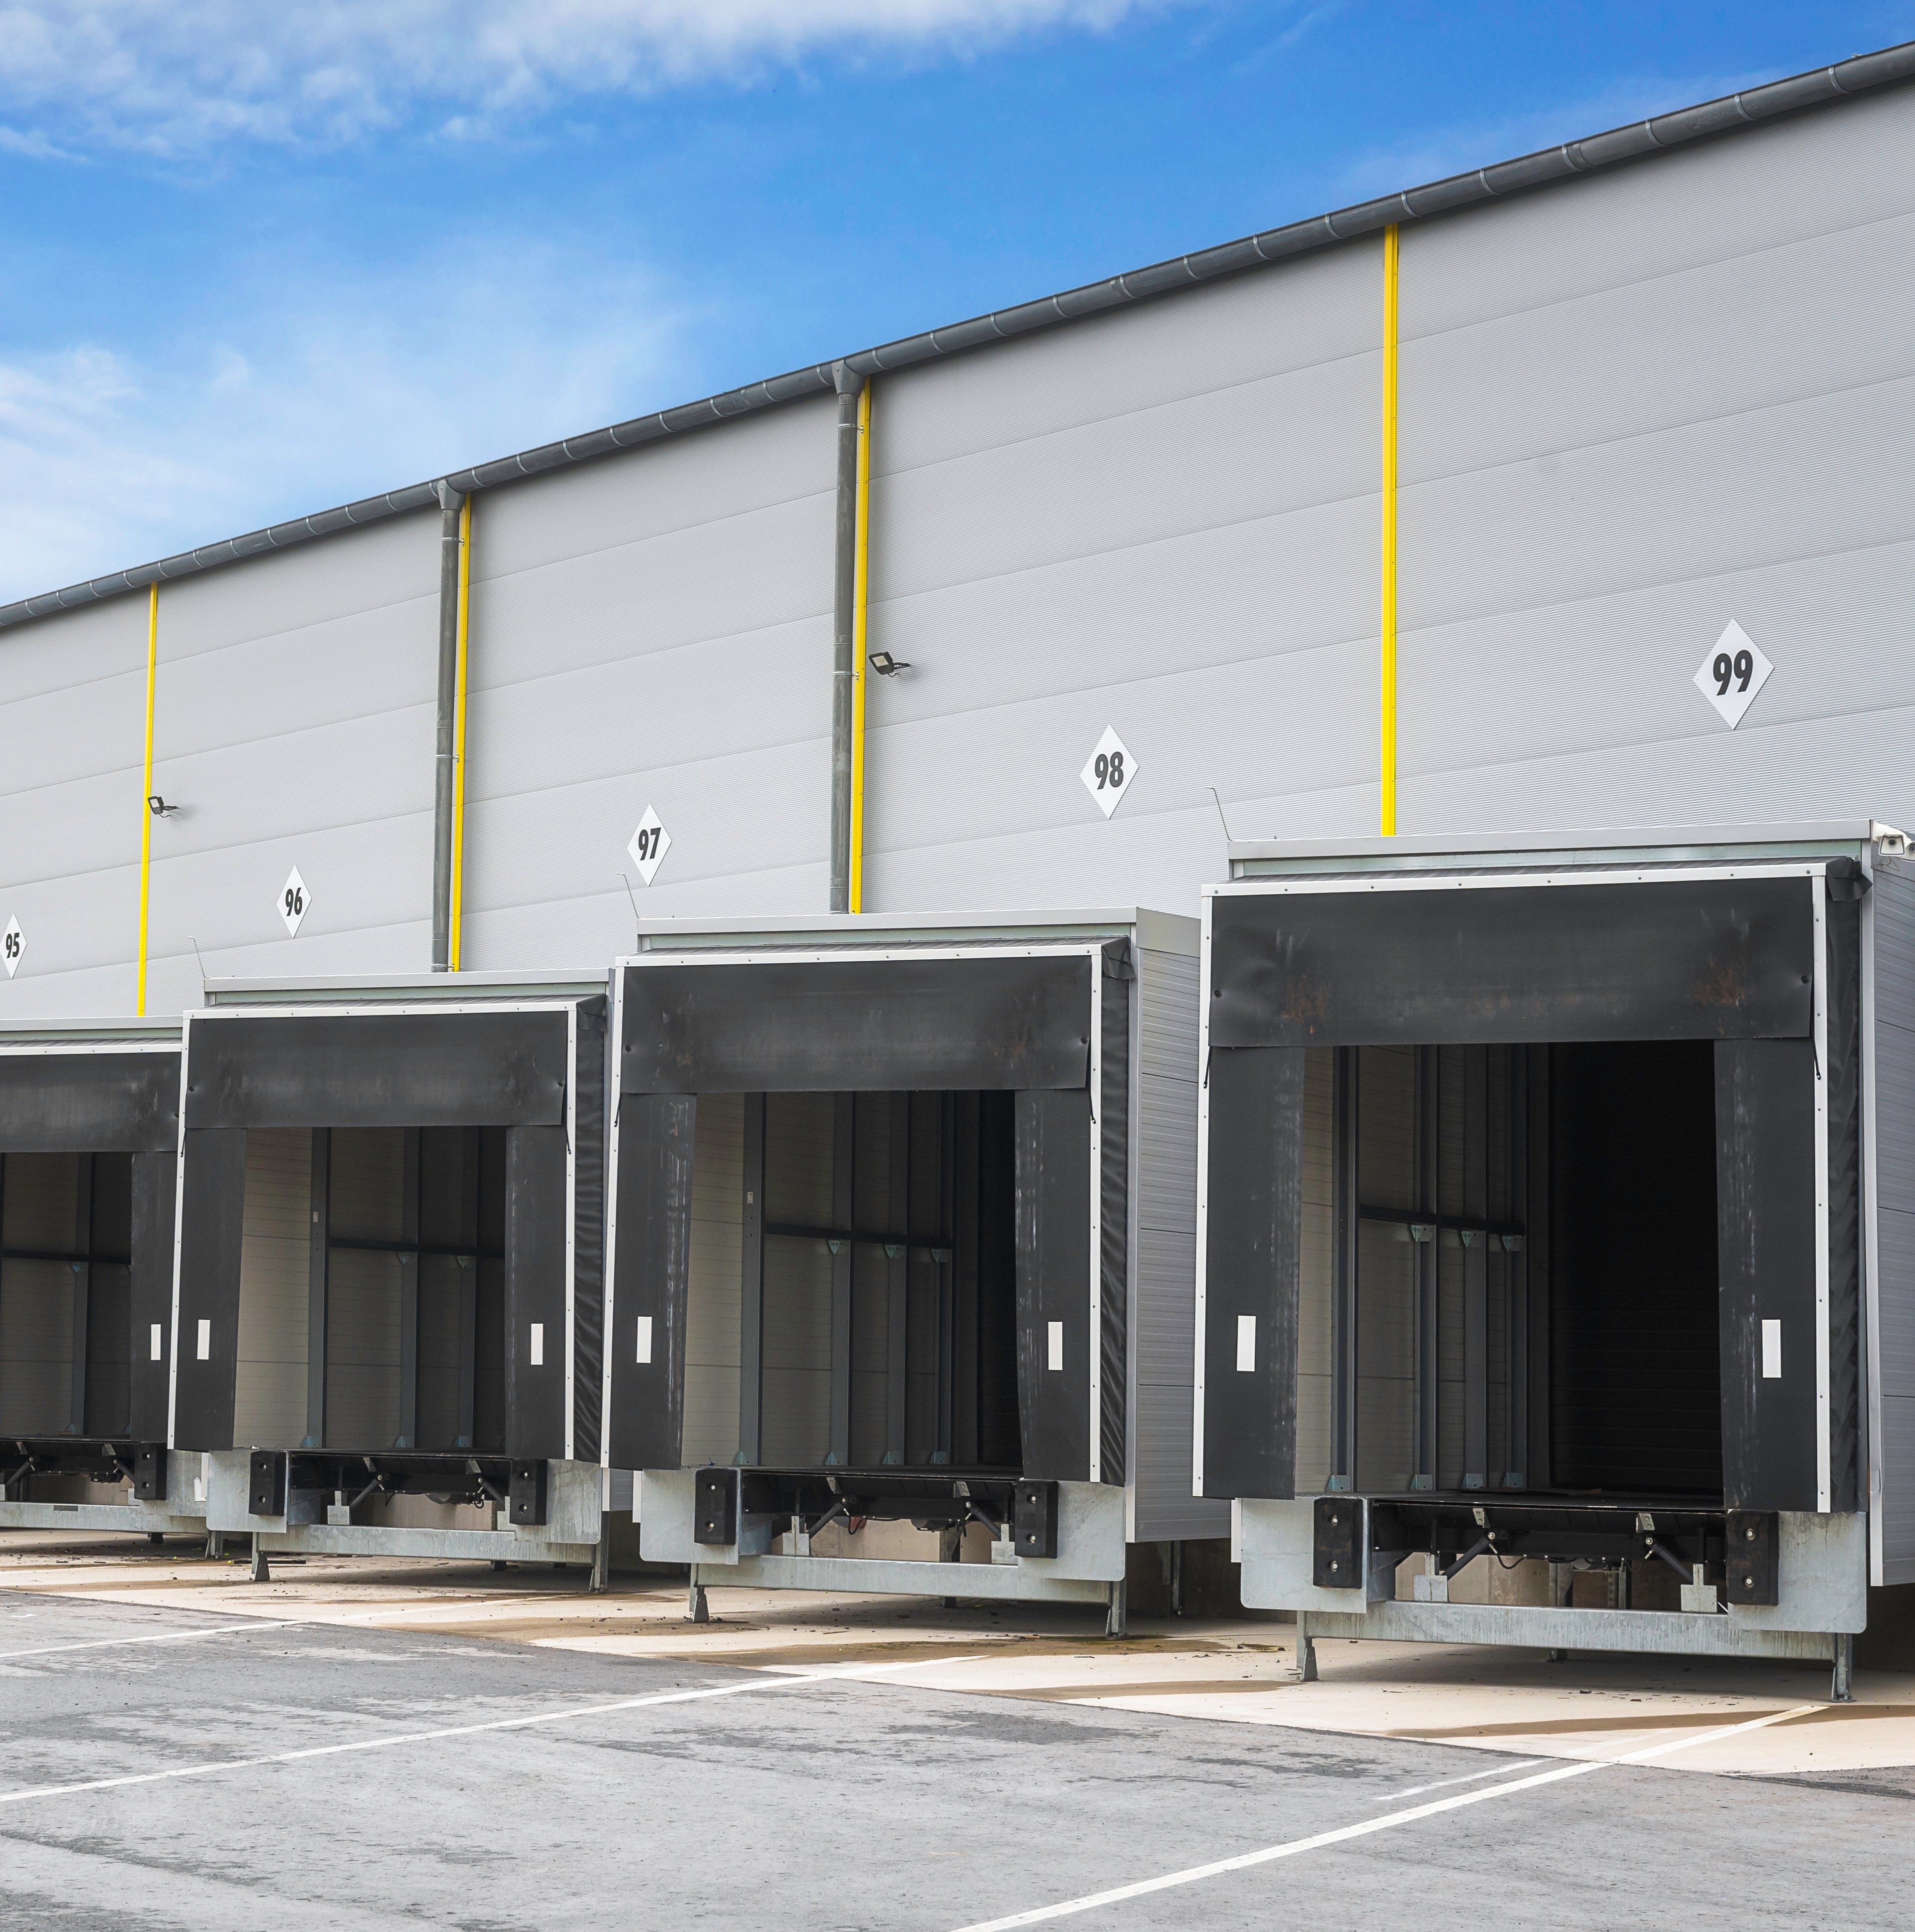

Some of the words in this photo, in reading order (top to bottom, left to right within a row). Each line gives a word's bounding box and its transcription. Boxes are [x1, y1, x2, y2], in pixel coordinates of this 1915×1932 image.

[1713, 650, 1753, 696] 99
[1094, 751, 1124, 790] 98
[638, 826, 662, 862] 97
[285, 886, 303, 917] 96
[5, 931, 20, 959] 95
